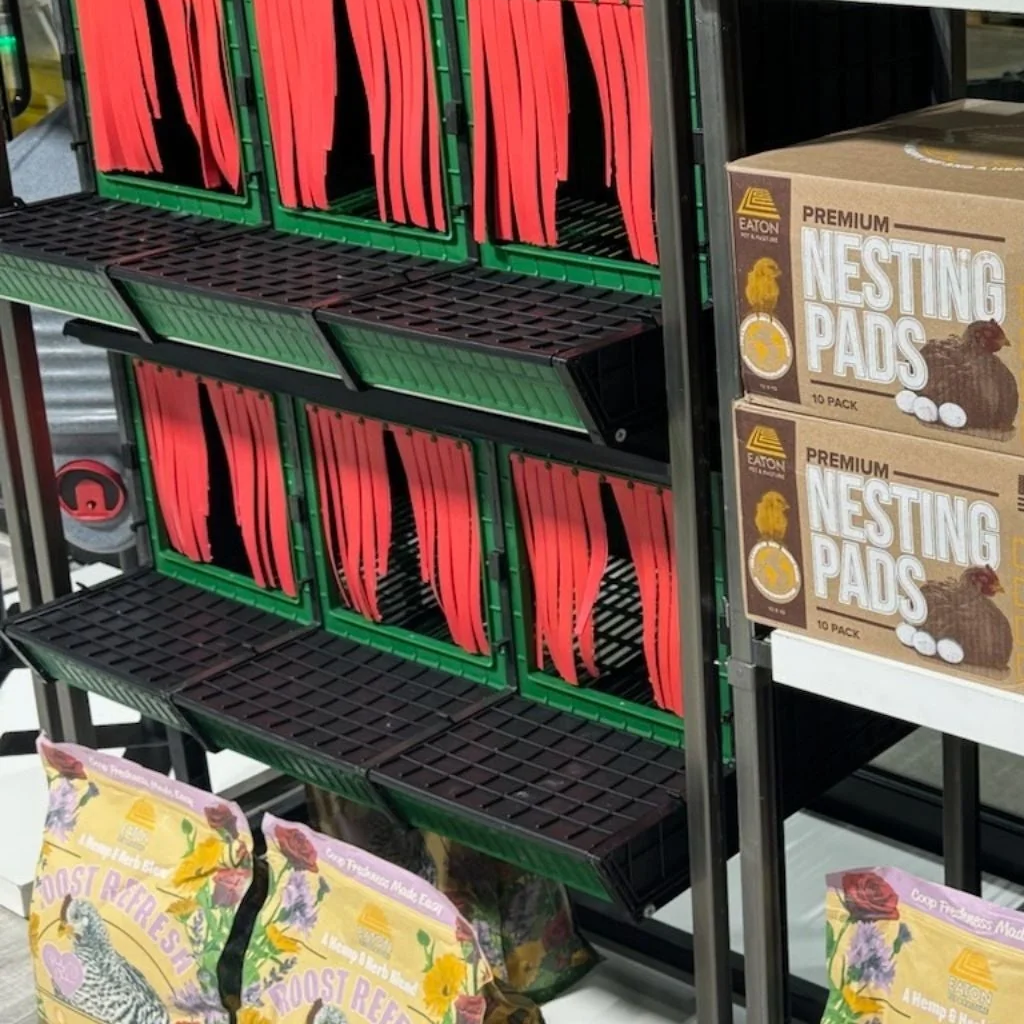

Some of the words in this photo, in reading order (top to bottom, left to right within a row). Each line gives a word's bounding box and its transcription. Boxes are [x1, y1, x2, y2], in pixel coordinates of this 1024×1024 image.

[739, 218, 779, 234] EATON
[803, 205, 889, 233] PREMIUM
[801, 226, 1006, 326] NESTING
[804, 301, 929, 391] PADS
[811, 394, 825, 404] 10
[827, 396, 859, 411] PACK
[747, 453, 785, 472] EATON
[806, 447, 889, 479] PREMIUM
[805, 464, 1001, 571] NESTING
[810, 531, 929, 626] PADS
[816, 619, 829, 631] 10
[831, 623, 861, 640] PACK
[911, 887, 938, 910] Coop
[938, 899, 994, 932] Freshness
[329, 935, 358, 964] Hemp
[364, 955, 389, 981] Herb
[389, 970, 419, 997] Blend
[268, 966, 350, 1017] ROOST
[902, 987, 910, 1004] A
[911, 990, 947, 1023] Hemp
[949, 978, 993, 1005] EATON
